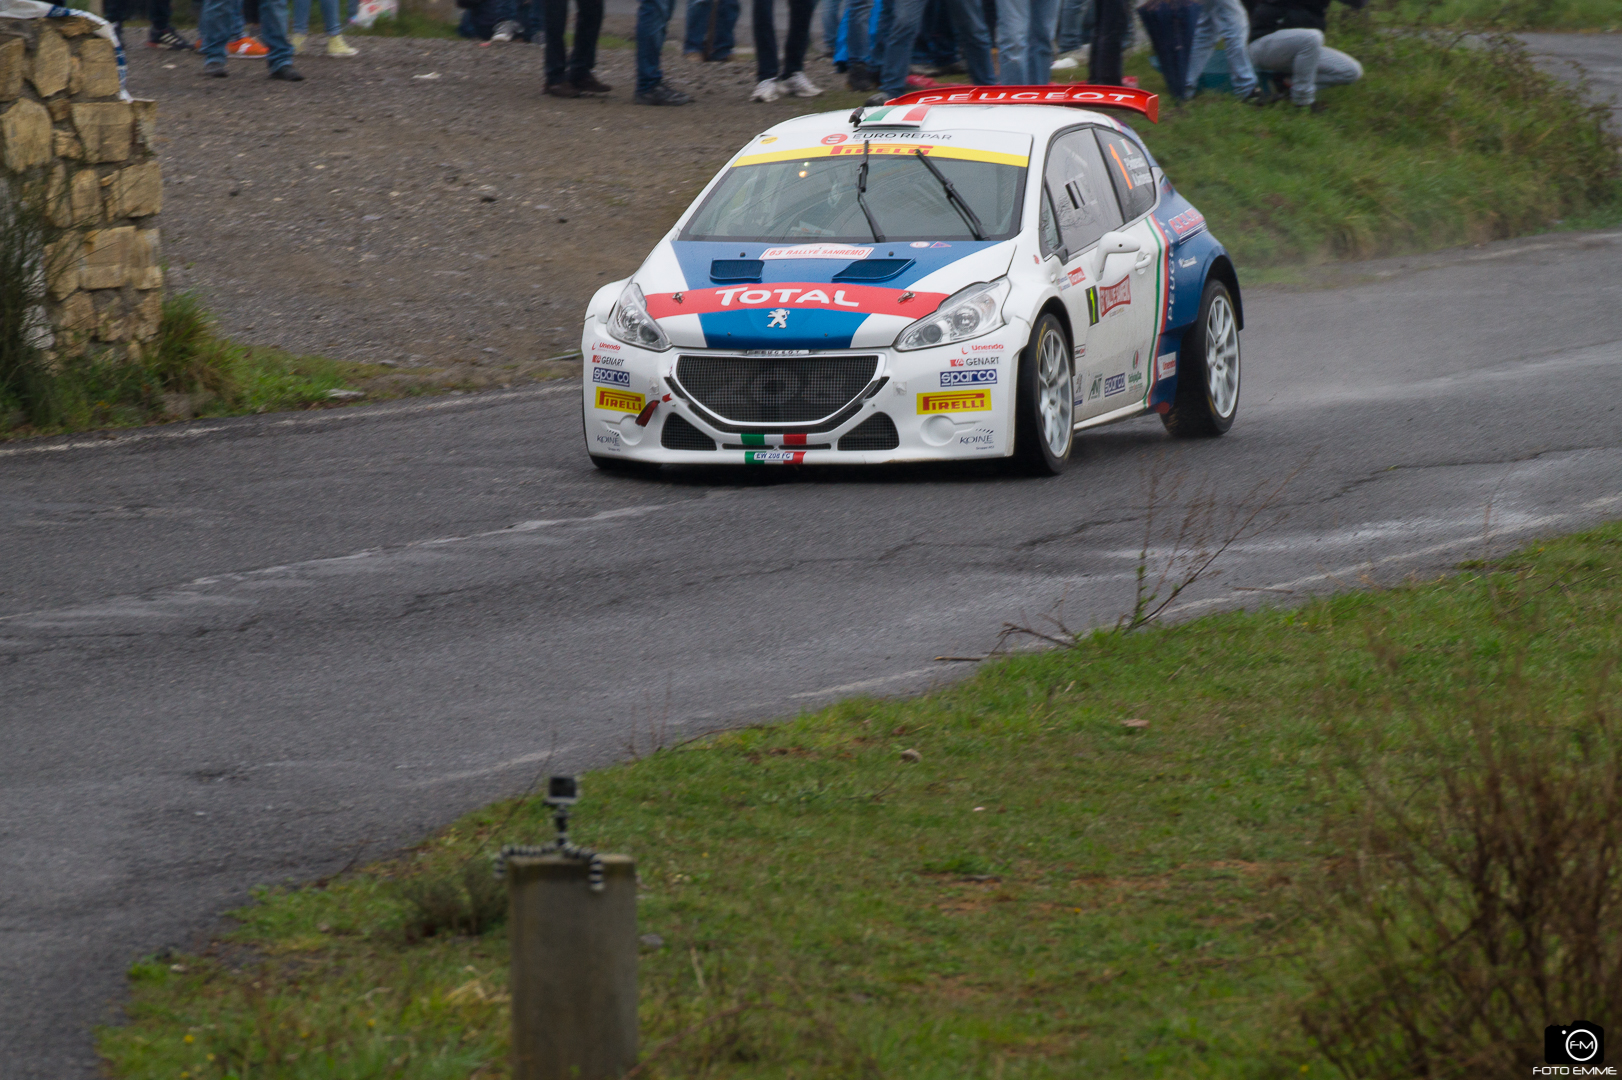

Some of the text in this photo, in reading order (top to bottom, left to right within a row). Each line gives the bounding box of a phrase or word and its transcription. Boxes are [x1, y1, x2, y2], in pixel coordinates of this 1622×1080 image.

[916, 92, 1135, 104] PEUGEOT
[853, 132, 897, 140] EURO
[899, 132, 953, 141] REPAR
[821, 249, 866, 257] SANREMO
[715, 287, 860, 307] TOTAL
[601, 356, 624, 367] GENART
[966, 357, 999, 367] GENART
[594, 368, 629, 384] sparco
[941, 370, 996, 386] sparco
[599, 391, 641, 411] PIRELLI
[923, 393, 985, 411] PIRELLI
